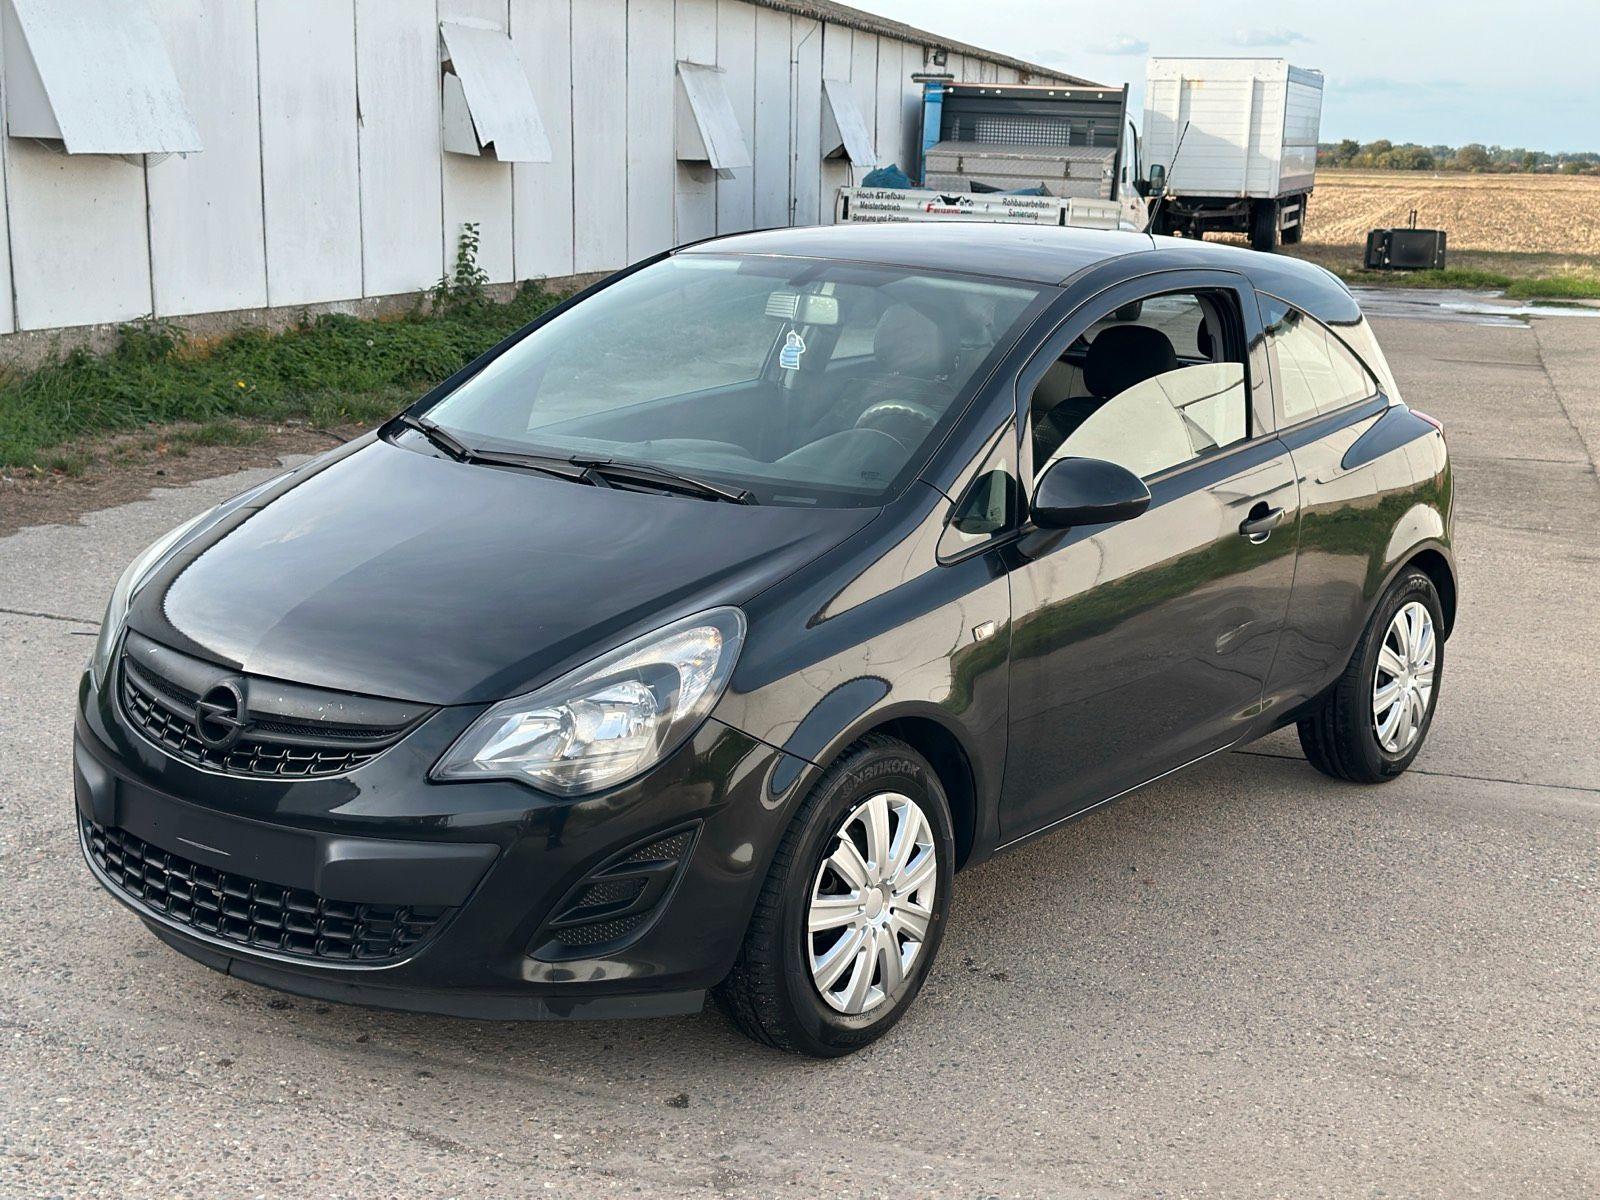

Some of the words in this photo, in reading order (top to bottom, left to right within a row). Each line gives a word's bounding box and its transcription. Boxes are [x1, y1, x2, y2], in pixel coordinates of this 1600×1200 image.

[856, 190, 874, 200] Hoch
[860, 201, 901, 211] Meisterbetrieb
[1002, 197, 1050, 209] Rohbauarbeiten
[877, 214, 887, 222] und
[1008, 208, 1039, 220] Sanierung
